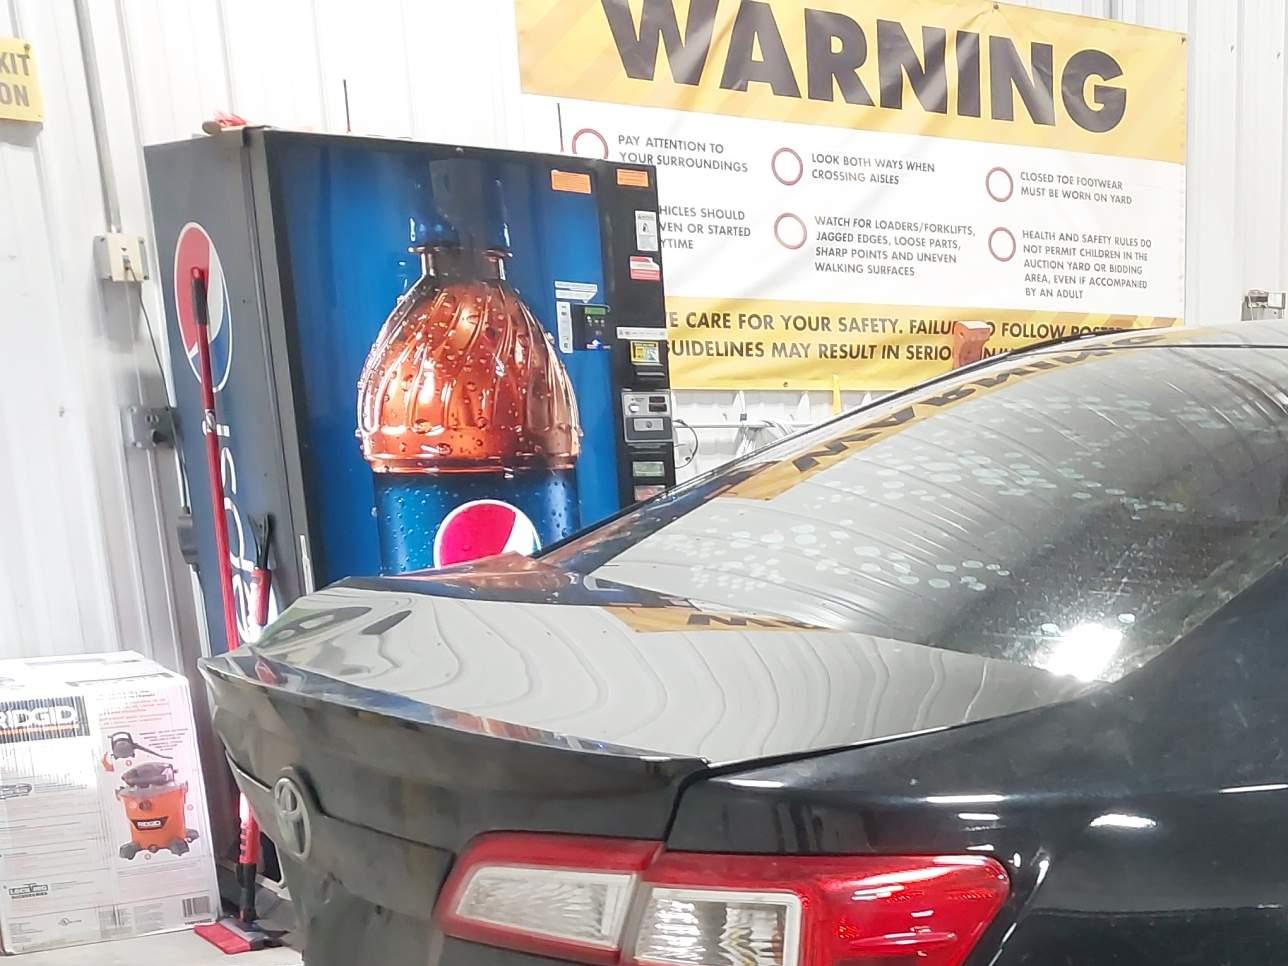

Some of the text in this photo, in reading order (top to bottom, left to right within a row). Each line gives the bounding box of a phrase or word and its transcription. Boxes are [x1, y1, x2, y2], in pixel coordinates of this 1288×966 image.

[601, 0, 1127, 134] WARNING
[618, 134, 724, 154] PAY ATTENTION TO
[619, 151, 748, 173] YOUR SURROUNDINGS
[812, 153, 935, 173] LOOK BOTH WAYS WHEN
[812, 169, 899, 185] CROSSING AISLES
[1021, 172, 1123, 190] CLOSED TOE FOOTWEAR
[1021, 187, 1132, 205] MUST BE WORN ON YARD
[659, 205, 745, 221] HICLES SHOULD
[659, 222, 751, 237] VEN OR STARTED
[814, 215, 976, 237] WATCH FOR LOADERS/FORKLIFTS,
[660, 238, 694, 249] YTIME
[816, 231, 961, 250] JAGGED EDGES, LOOSE PARTS,
[1022, 230, 1152, 248] HEALTH AND SAFETY RULES DO
[815, 247, 957, 264] SHARP POINTS AND UNEVEN
[1023, 245, 1148, 262] NOT PERMIT CHILDREN IN THE
[815, 262, 915, 277] WALKING SURFACES
[1024, 259, 1143, 275] AUCTION YARD OR BIDDING
[1024, 273, 1148, 289] AREA, EVEN IF ACCOMPANIED
[1025, 287, 1084, 299] BY AN ADULT
[669, 311, 679, 328] E
[686, 311, 731, 330] CARE
[738, 313, 775, 331] FOR
[780, 315, 832, 333] YOUR
[838, 316, 903, 335] SAFETY.
[909, 319, 957, 337] FAILU
[1001, 322, 1066, 339] FOLLOW
[771, 342, 812, 359] MAY
[818, 343, 878, 361] RESULT
[881, 344, 900, 361] IN
[906, 344, 951, 361] SERIO
